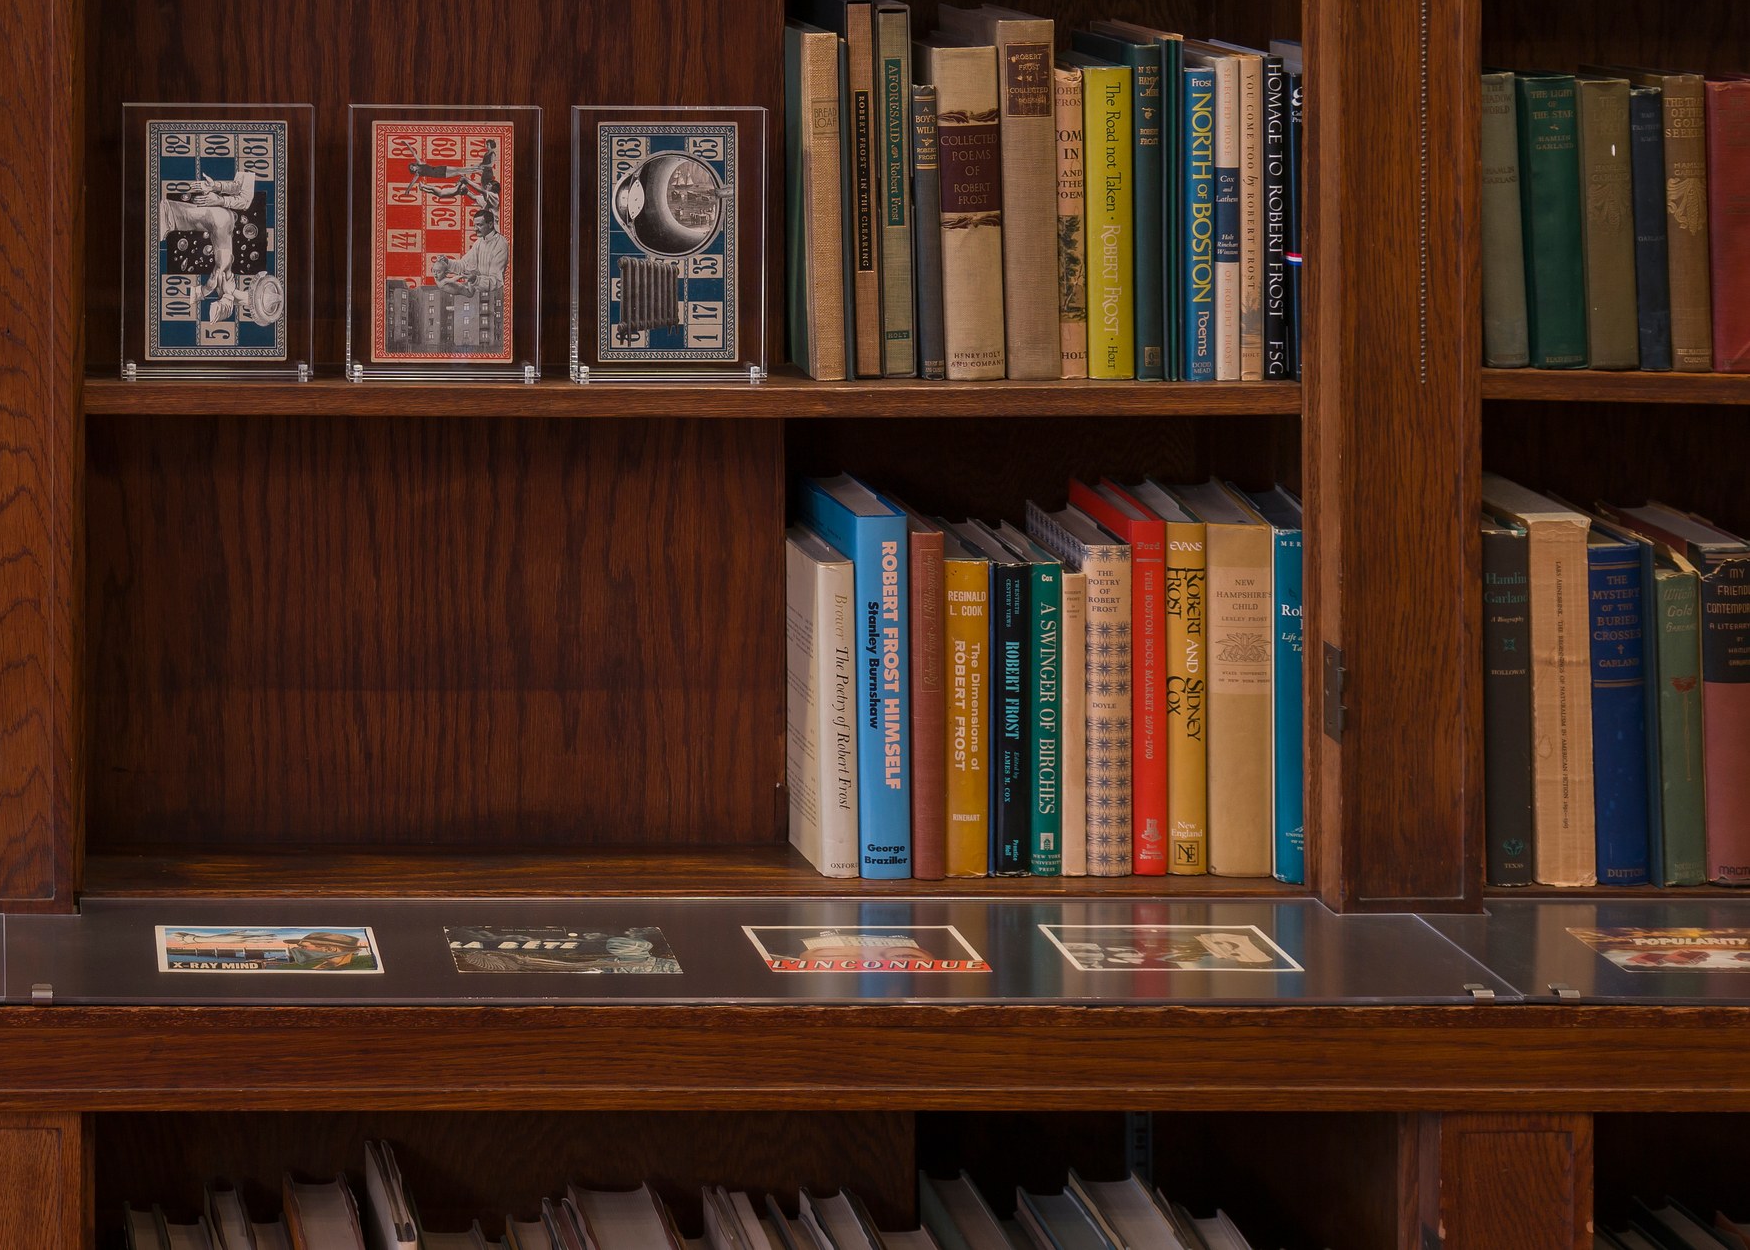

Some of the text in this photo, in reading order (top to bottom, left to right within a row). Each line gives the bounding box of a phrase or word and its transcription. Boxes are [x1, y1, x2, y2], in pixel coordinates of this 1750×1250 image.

[1191, 78, 1212, 87] Frost
[166, 134, 193, 156] 82
[430, 208, 458, 228] 59
[1102, 82, 1121, 335] The Road not Taken ROBERT FROST
[1191, 93, 1212, 356] NORTH OF BOSTON Poems
[692, 302, 719, 323] 17
[866, 602, 880, 729] Stanley Burnshaw
[882, 541, 901, 789] ROBERT FROST HIMSELF
[1039, 602, 1056, 814] A SWINGER OF BIRCHES
[867, 844, 905, 854] George
[864, 855, 907, 866] Braziller
[1631, 937, 1748, 946] POPULARITY
[172, 962, 258, 970] X-RAY MIND
[771, 960, 984, 969] L'INCONNUE
